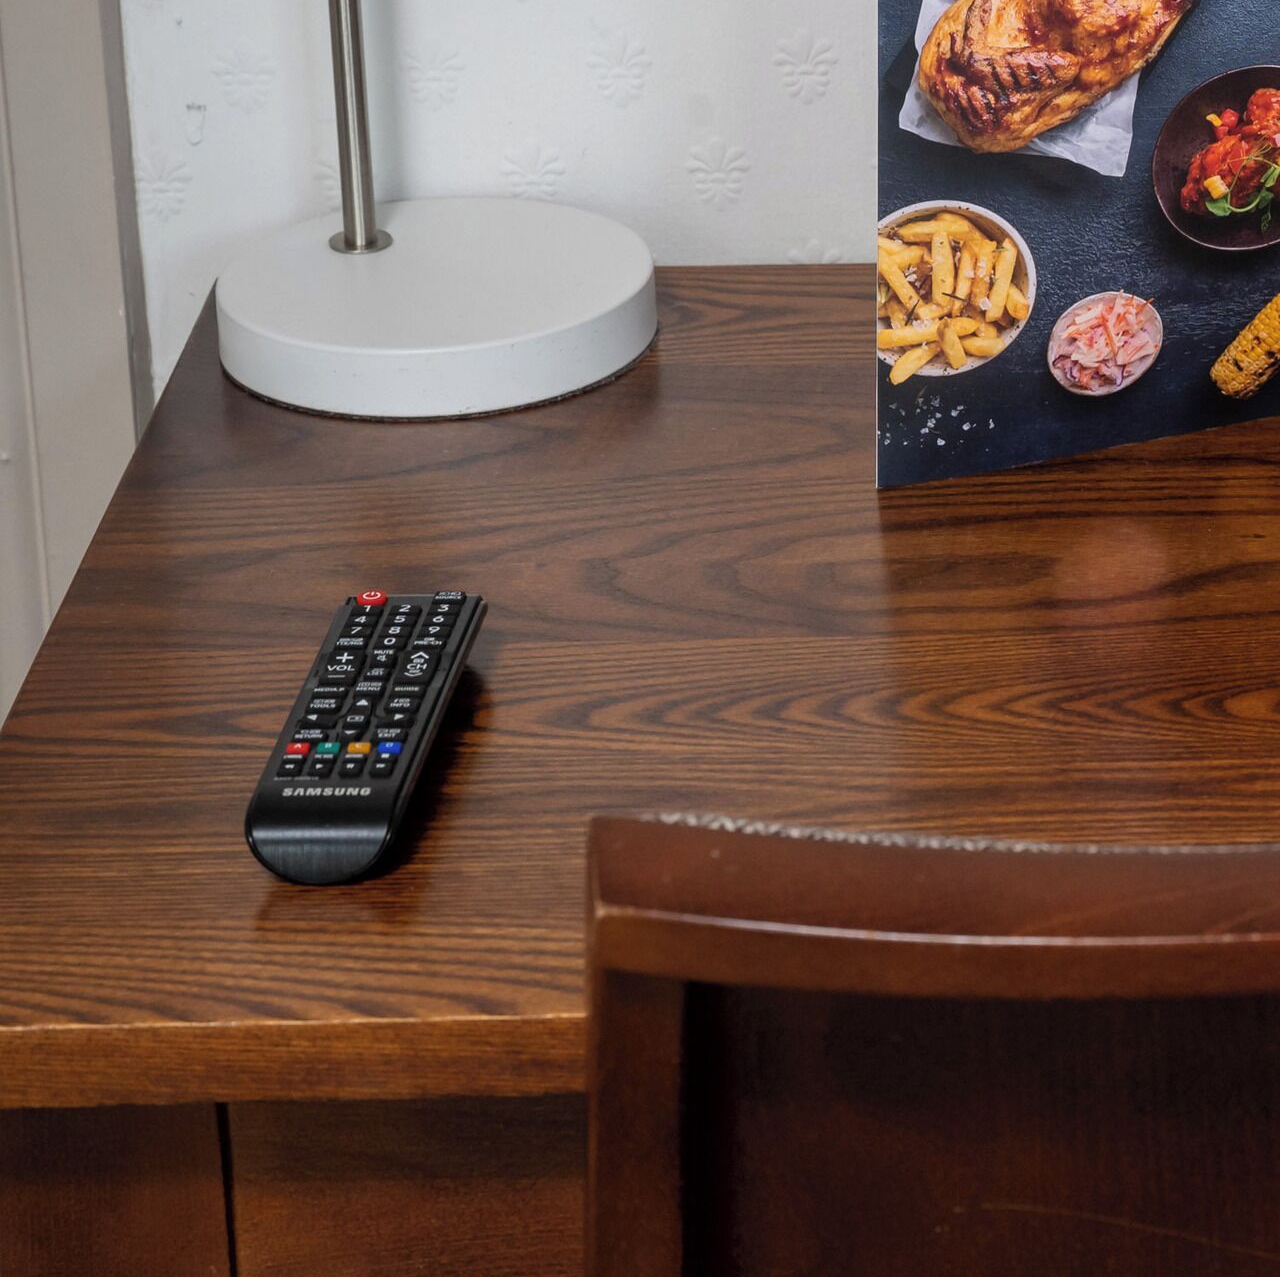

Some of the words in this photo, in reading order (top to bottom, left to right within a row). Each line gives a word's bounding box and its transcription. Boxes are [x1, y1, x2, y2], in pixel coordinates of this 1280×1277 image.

[399, 604, 411, 612] 2
[437, 604, 450, 612] 3
[394, 615, 406, 623] 5
[432, 615, 444, 623] 6
[351, 626, 362, 634] 7
[388, 626, 401, 634] 8
[428, 626, 441, 634] 9
[384, 637, 396, 645] 0
[327, 664, 355, 672] VOL
[282, 787, 372, 797] SAMSUNG
